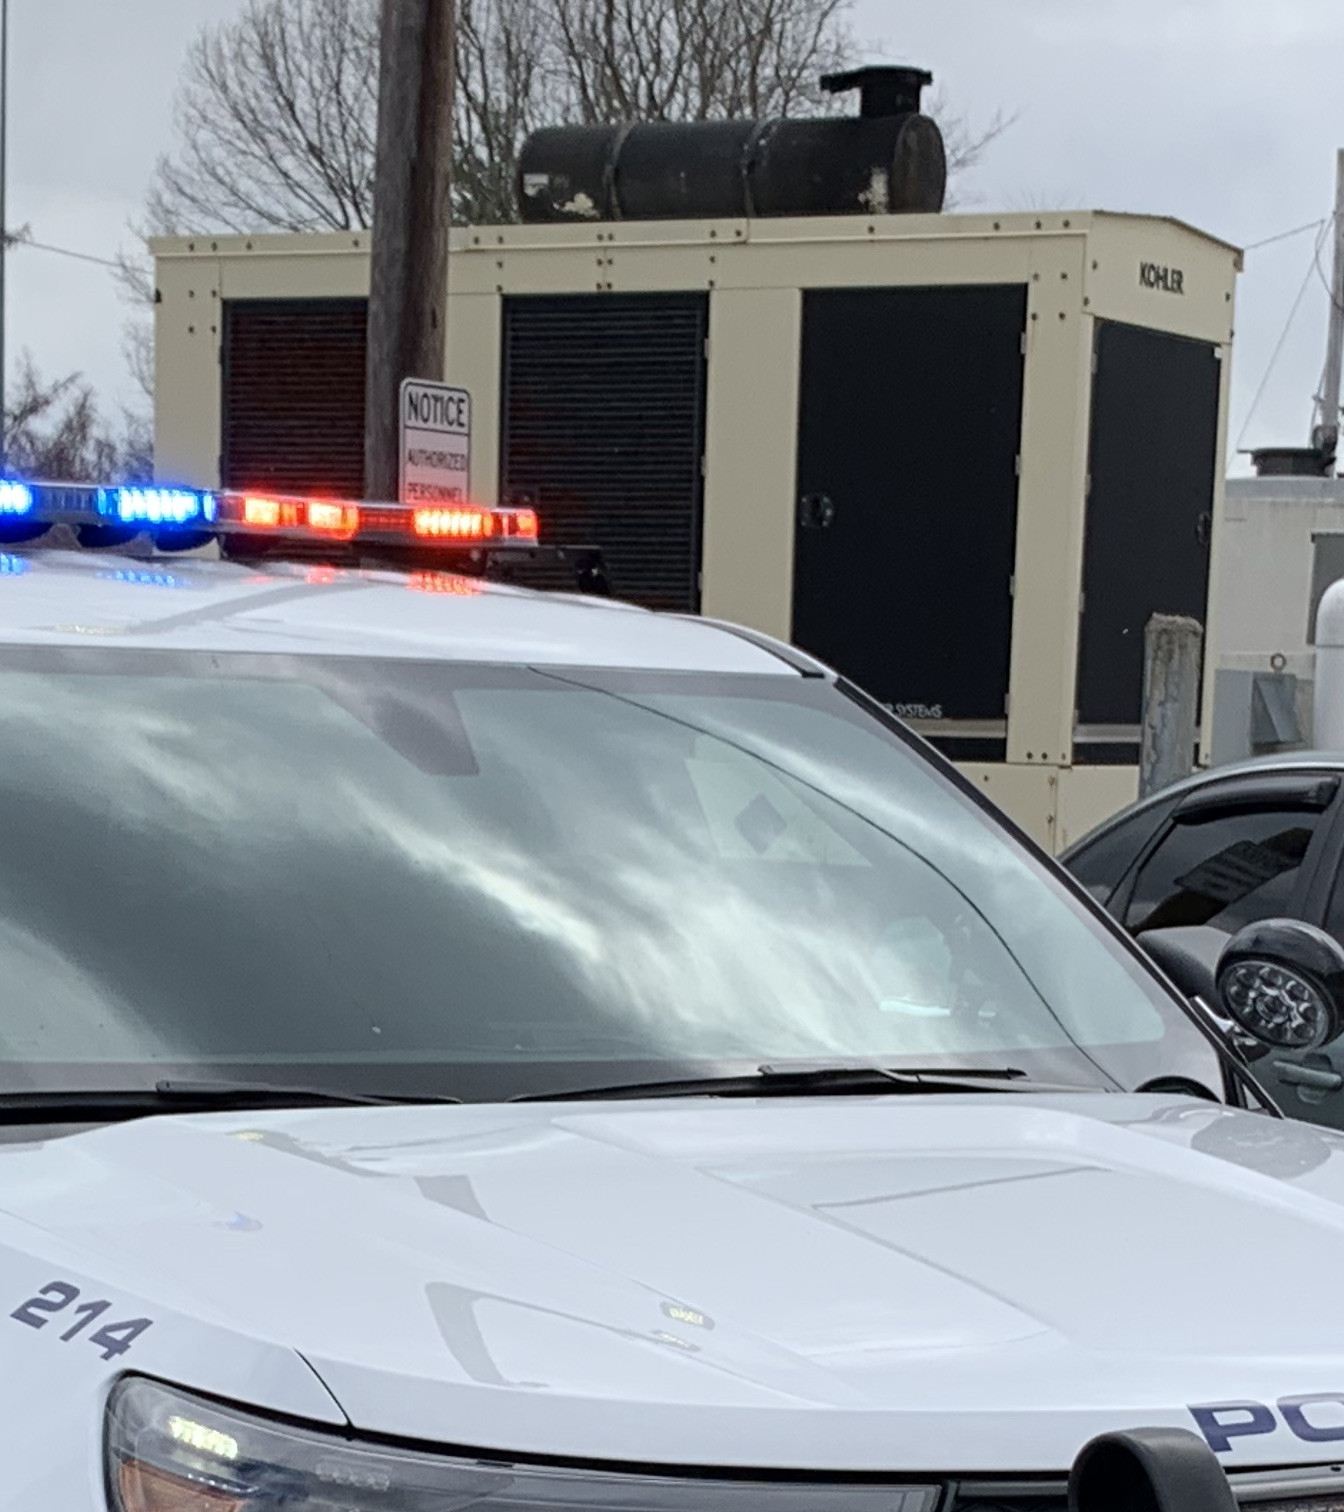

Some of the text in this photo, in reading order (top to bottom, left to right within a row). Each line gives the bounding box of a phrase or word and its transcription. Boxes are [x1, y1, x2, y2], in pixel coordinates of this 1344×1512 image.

[1139, 261, 1185, 295] KOHLER
[408, 392, 466, 427] NOTICE
[408, 448, 466, 472] AUTHORIZED
[9, 1281, 154, 1361] 214
